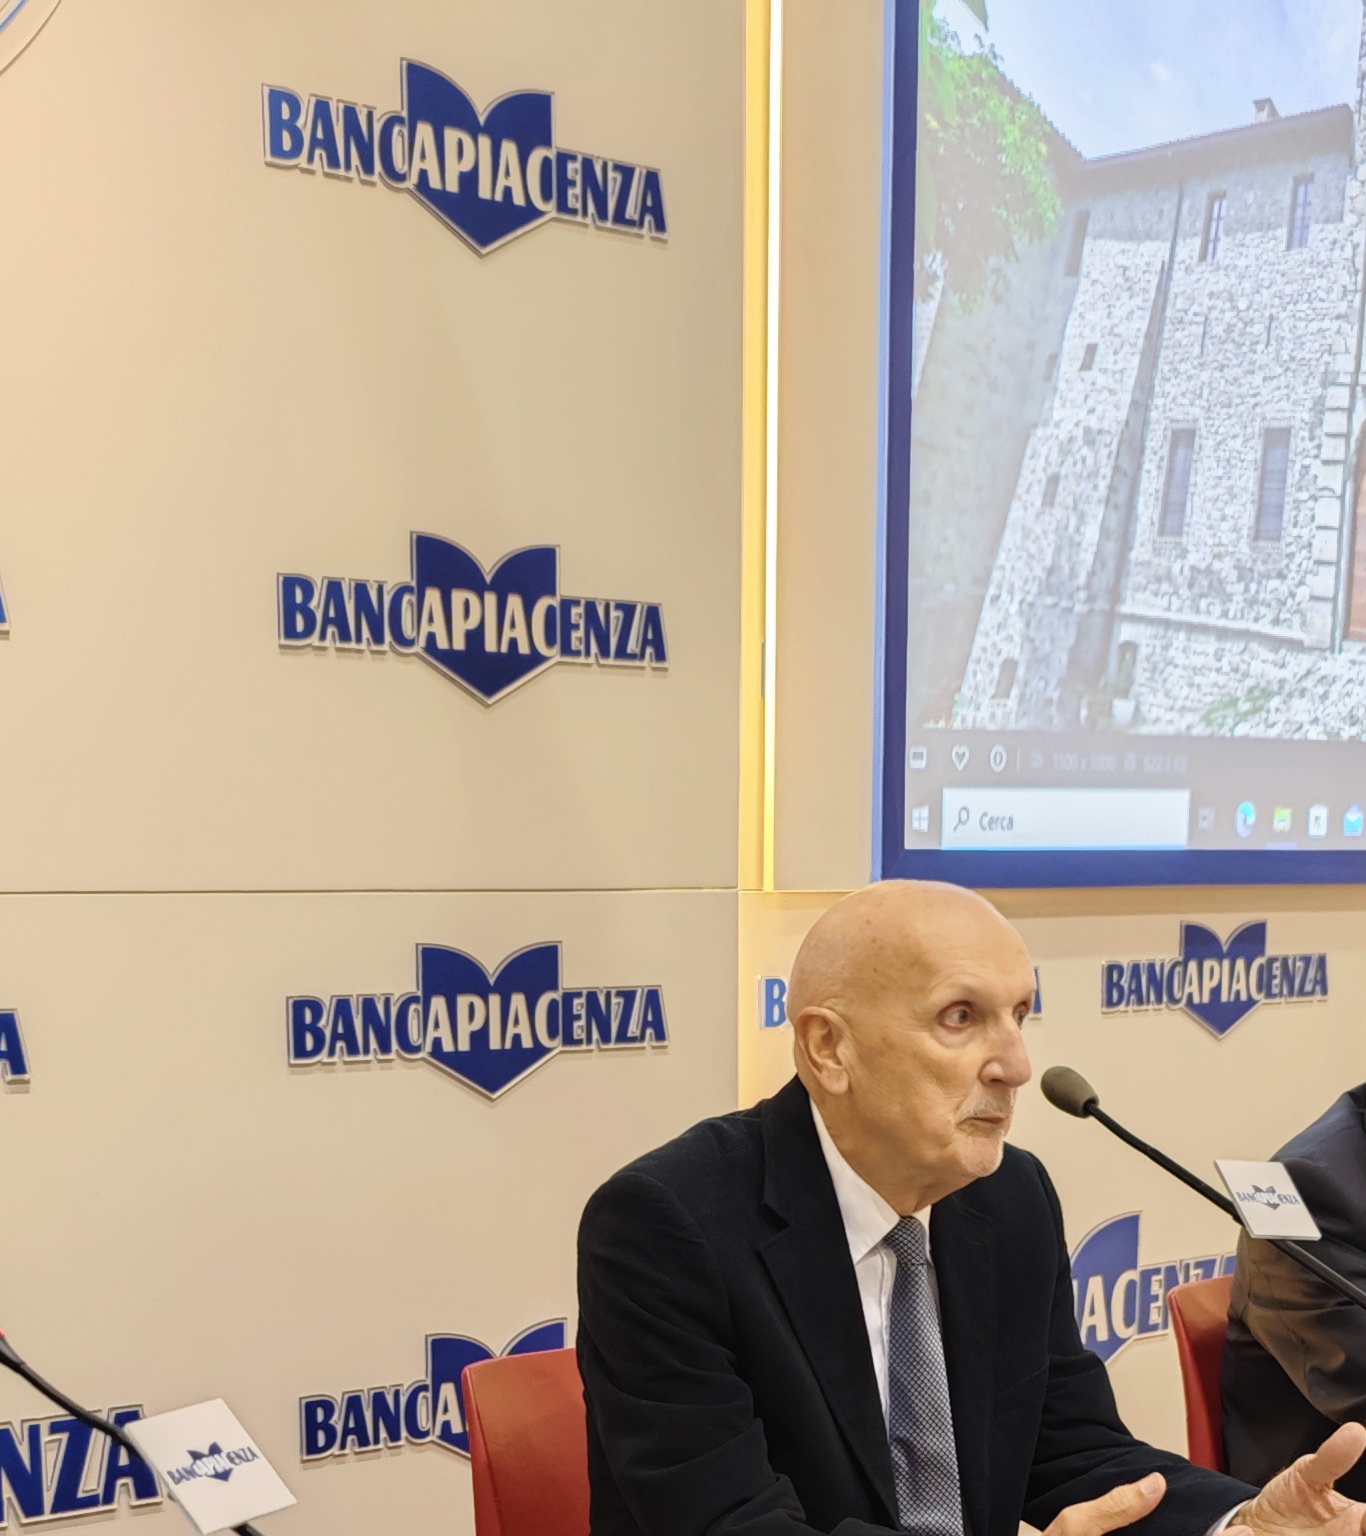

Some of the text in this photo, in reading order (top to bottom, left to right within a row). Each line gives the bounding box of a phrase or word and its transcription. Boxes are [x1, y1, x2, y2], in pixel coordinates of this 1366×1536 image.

[268, 87, 667, 233] BANCAPIACENZA
[282, 575, 668, 663] BANCAPIACENZA
[978, 811, 1014, 832] Cerca
[1104, 954, 1329, 1009] BANCAPIACENZA
[291, 987, 667, 1060] BANCAPIACENZA
